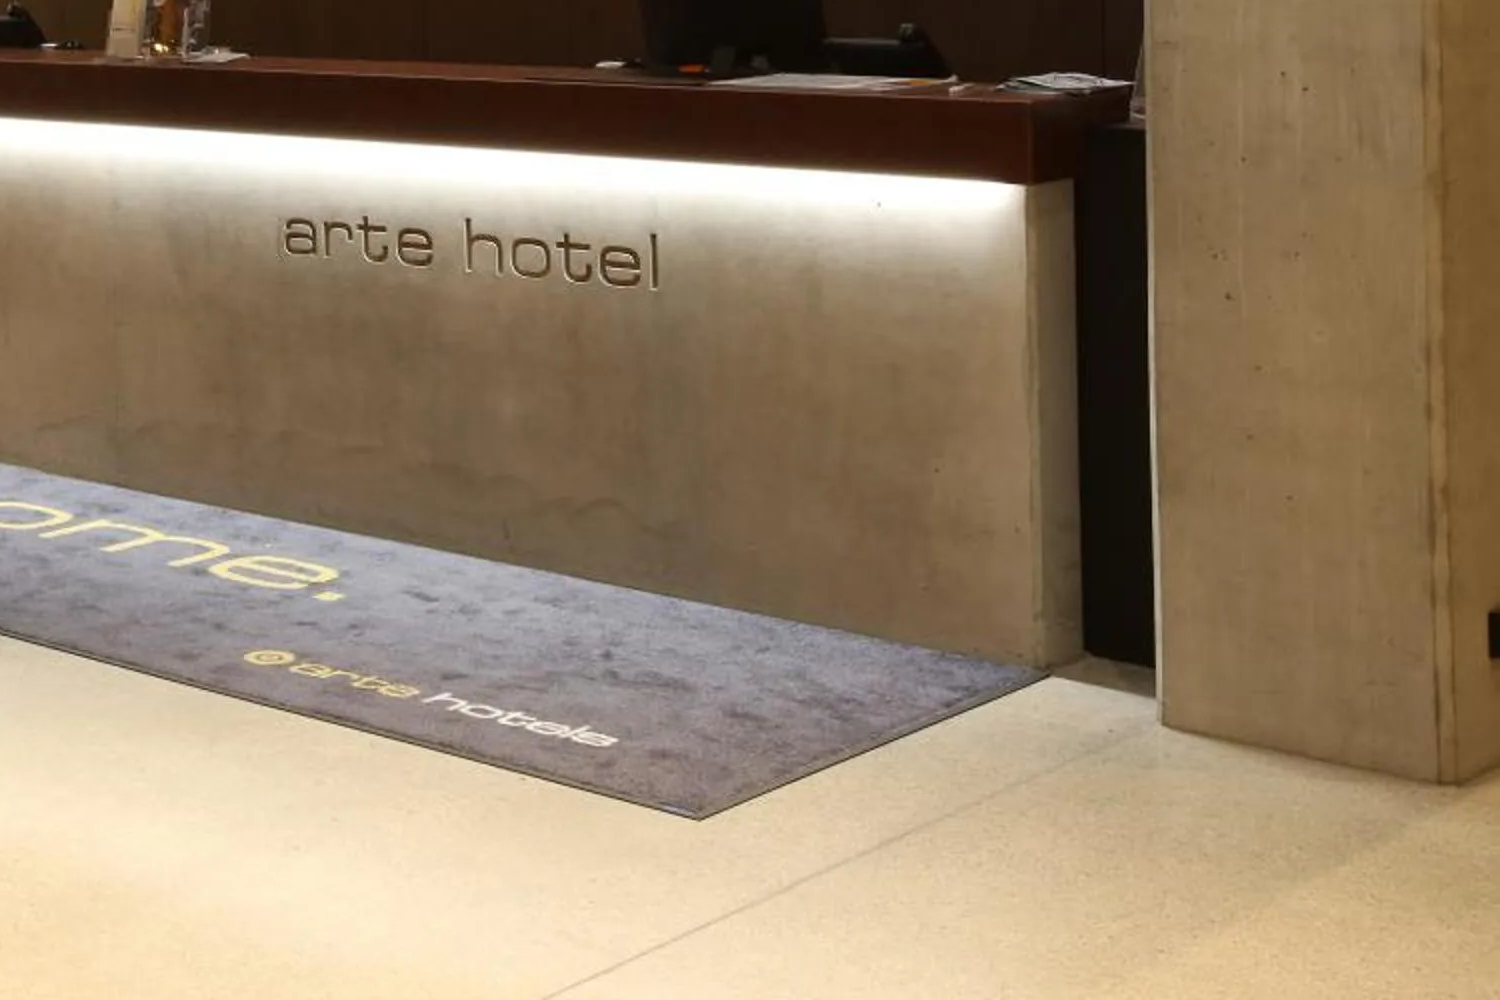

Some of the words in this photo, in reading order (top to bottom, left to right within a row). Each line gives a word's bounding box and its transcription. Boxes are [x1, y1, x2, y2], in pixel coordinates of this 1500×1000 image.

[284, 215, 434, 267] arte
[463, 217, 659, 292] hotel
[289, 662, 421, 699] arte
[421, 692, 619, 748] hotels
